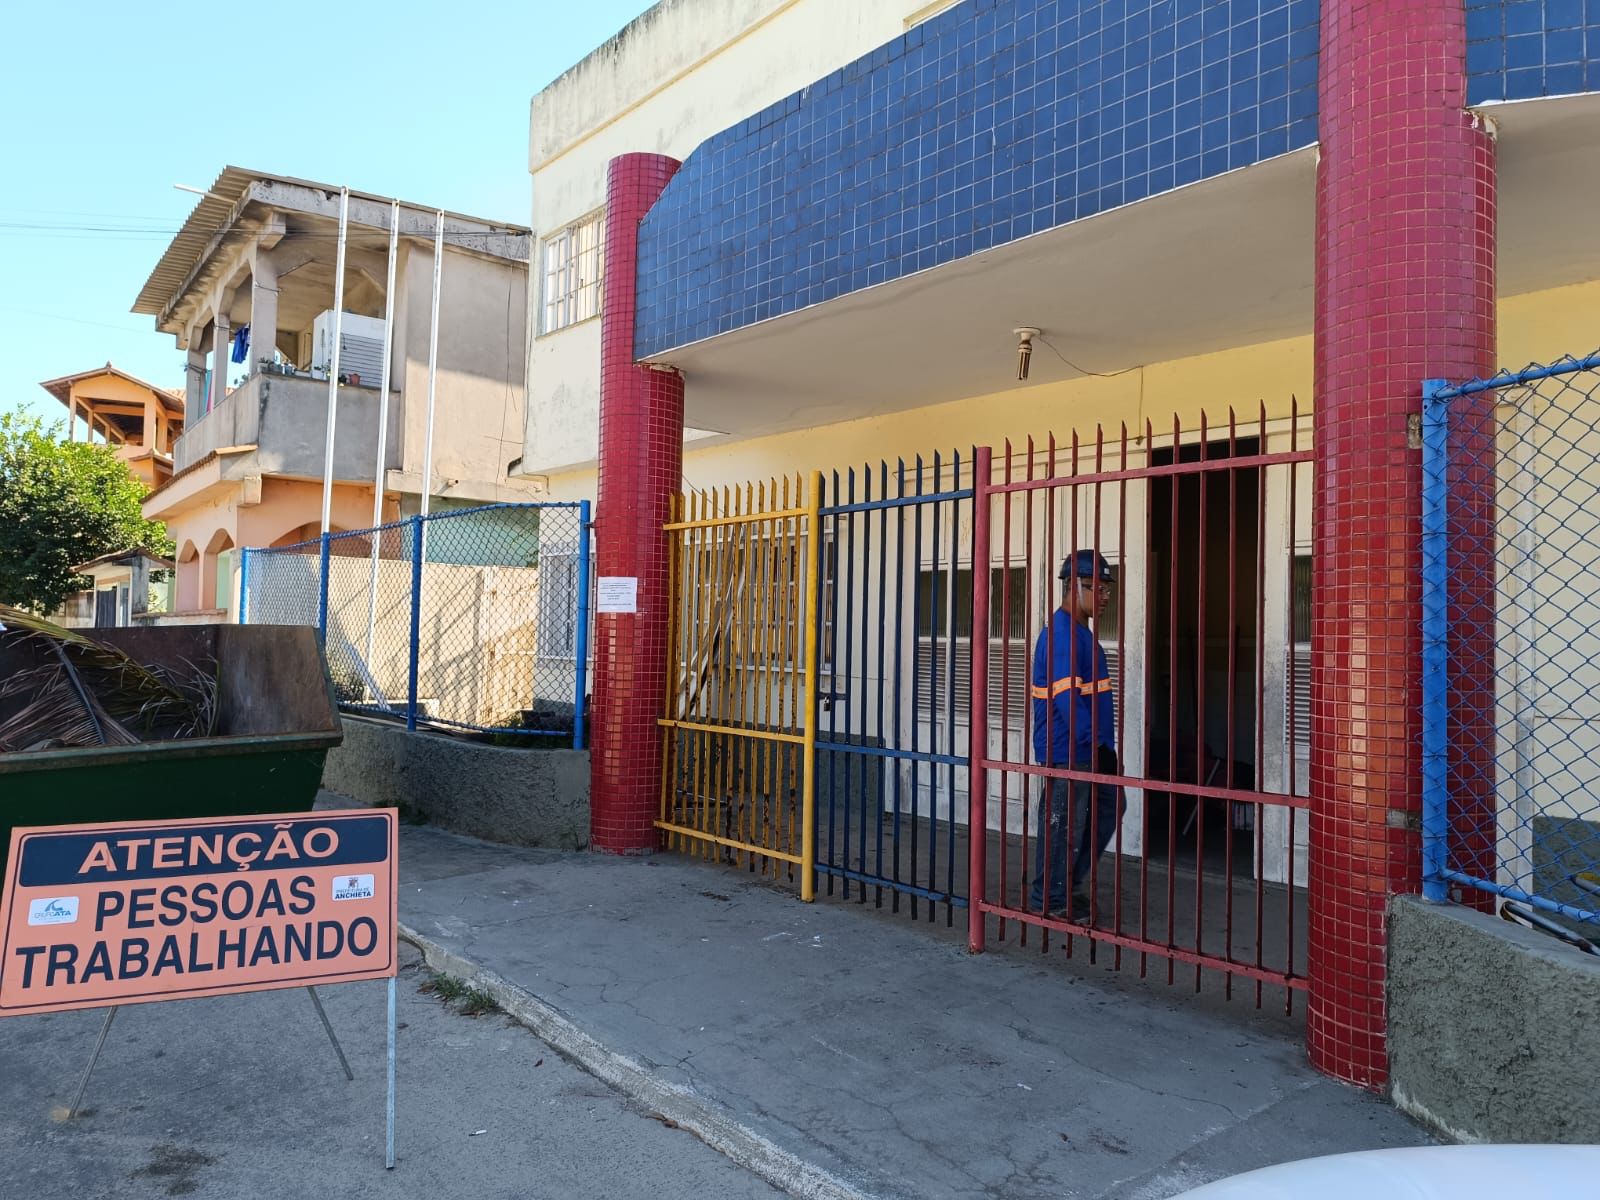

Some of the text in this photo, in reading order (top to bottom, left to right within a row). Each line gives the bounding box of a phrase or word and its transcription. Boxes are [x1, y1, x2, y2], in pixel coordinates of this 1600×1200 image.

[78, 823, 340, 874] ATENÇÃO
[94, 876, 316, 932] PESSOAS
[335, 891, 371, 899] ANCHIETA
[15, 917, 378, 989] TRABALHANDO
